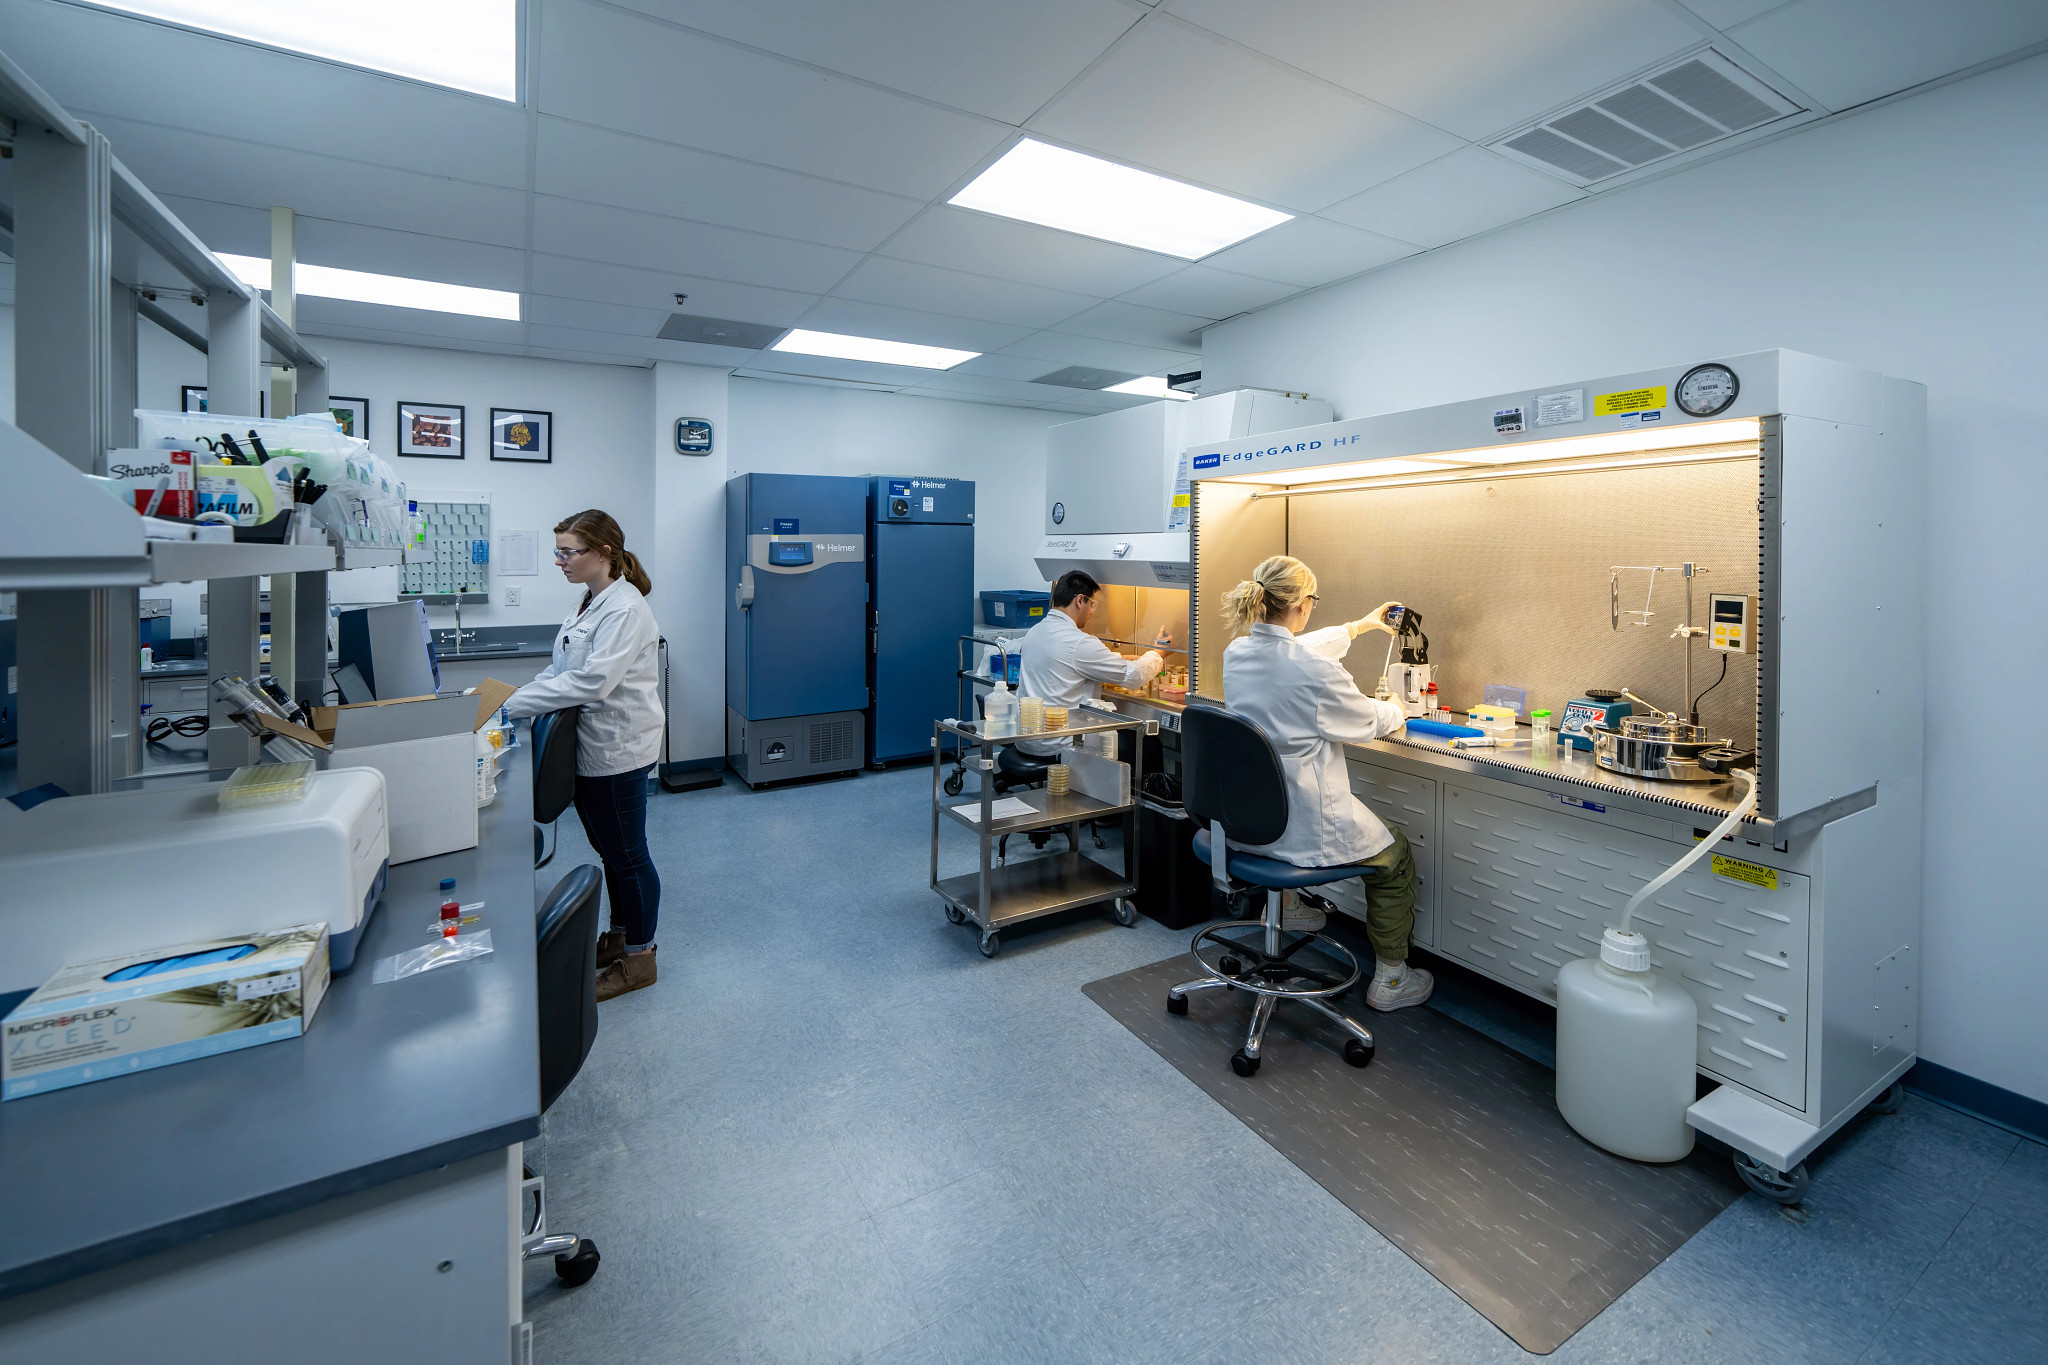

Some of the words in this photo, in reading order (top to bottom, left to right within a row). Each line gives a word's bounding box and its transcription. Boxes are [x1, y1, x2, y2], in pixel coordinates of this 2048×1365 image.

[1222, 440, 1323, 462] EdgeGARD
[1333, 434, 1361, 447] HF
[1195, 457, 1218, 465] BAKER
[110, 462, 174, 480] Sharpie
[921, 480, 947, 490] Helmer
[827, 543, 856, 552] Helmer
[1724, 858, 1764, 873] WARNING
[8, 1007, 119, 1037] MICROFLEX
[10, 1018, 132, 1056] XCEED
